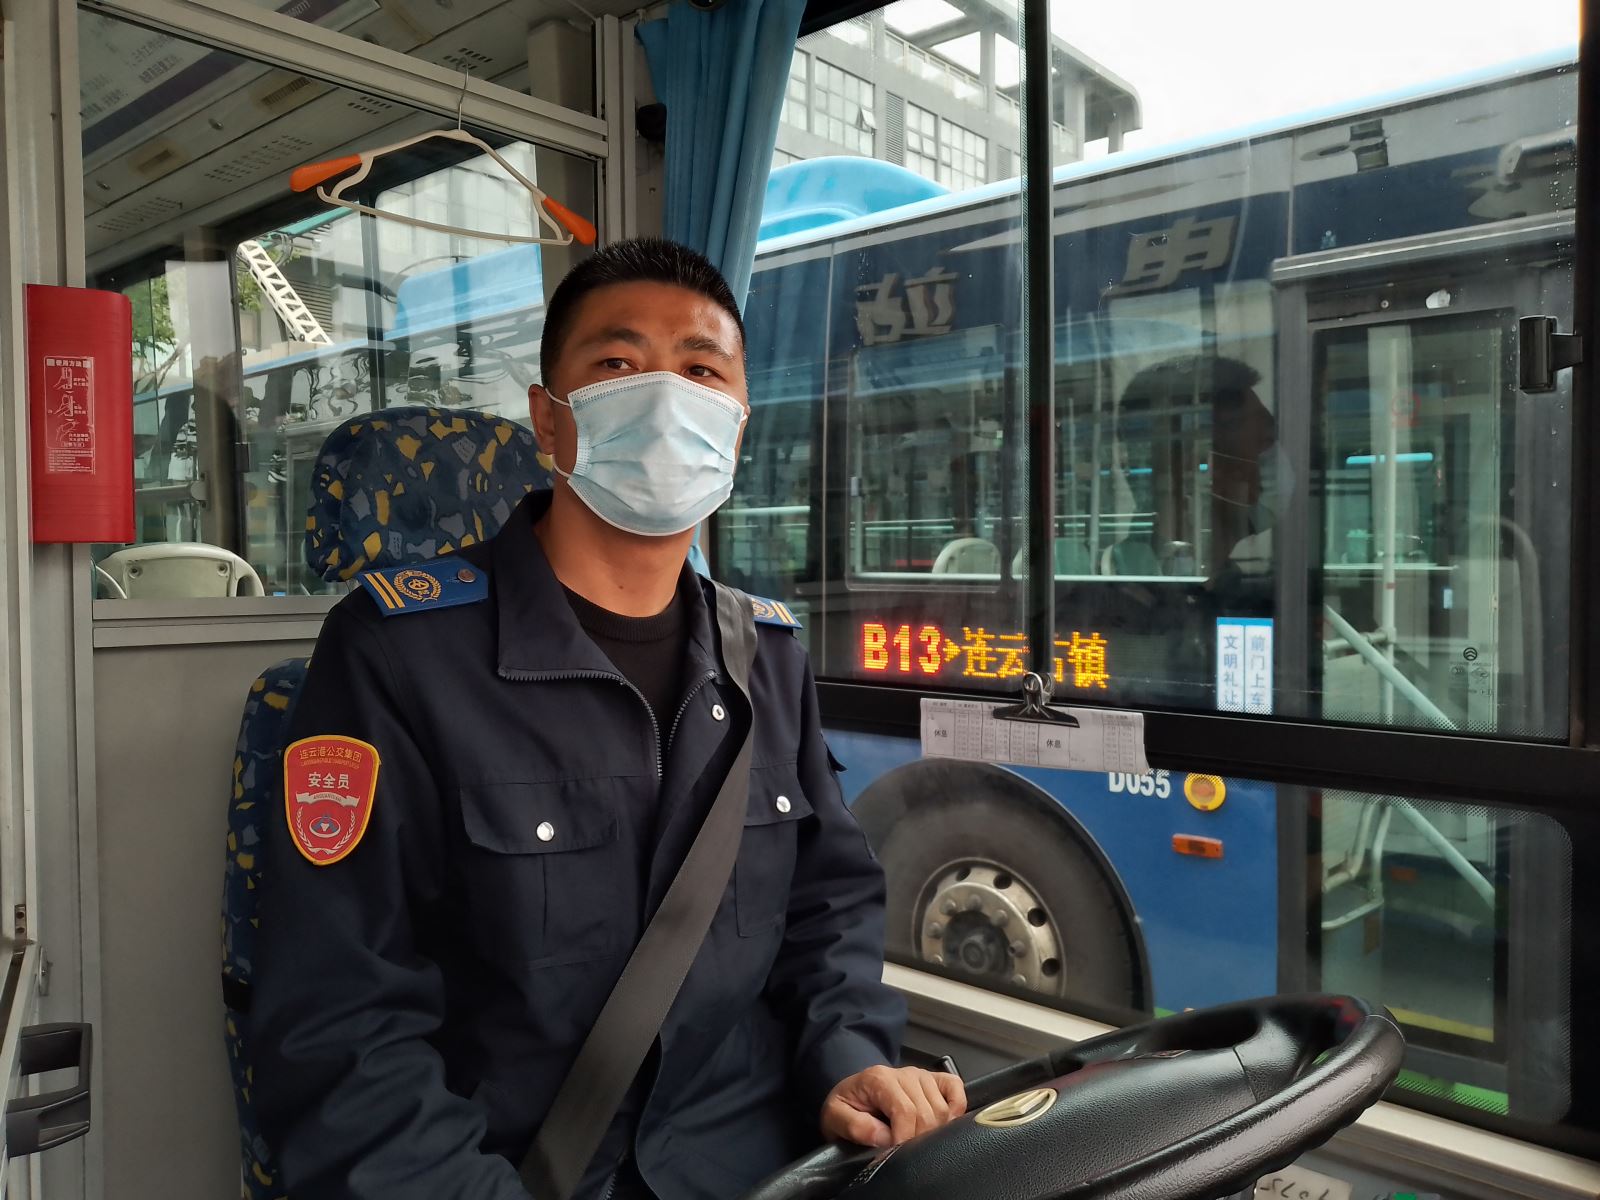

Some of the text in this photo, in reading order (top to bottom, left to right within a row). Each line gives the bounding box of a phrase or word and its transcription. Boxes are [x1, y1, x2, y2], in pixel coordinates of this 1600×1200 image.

[863, 623, 941, 674] B13
[1224, 635, 1238, 705] 文明礼让
[1251, 635, 1265, 705] 前门上车
[934, 729, 948, 738] 休息
[1046, 738, 1061, 748] 休息
[300, 745, 362, 763] 连云港公交集团
[308, 771, 350, 790] 安全员
[1108, 768, 1172, 799] D055
